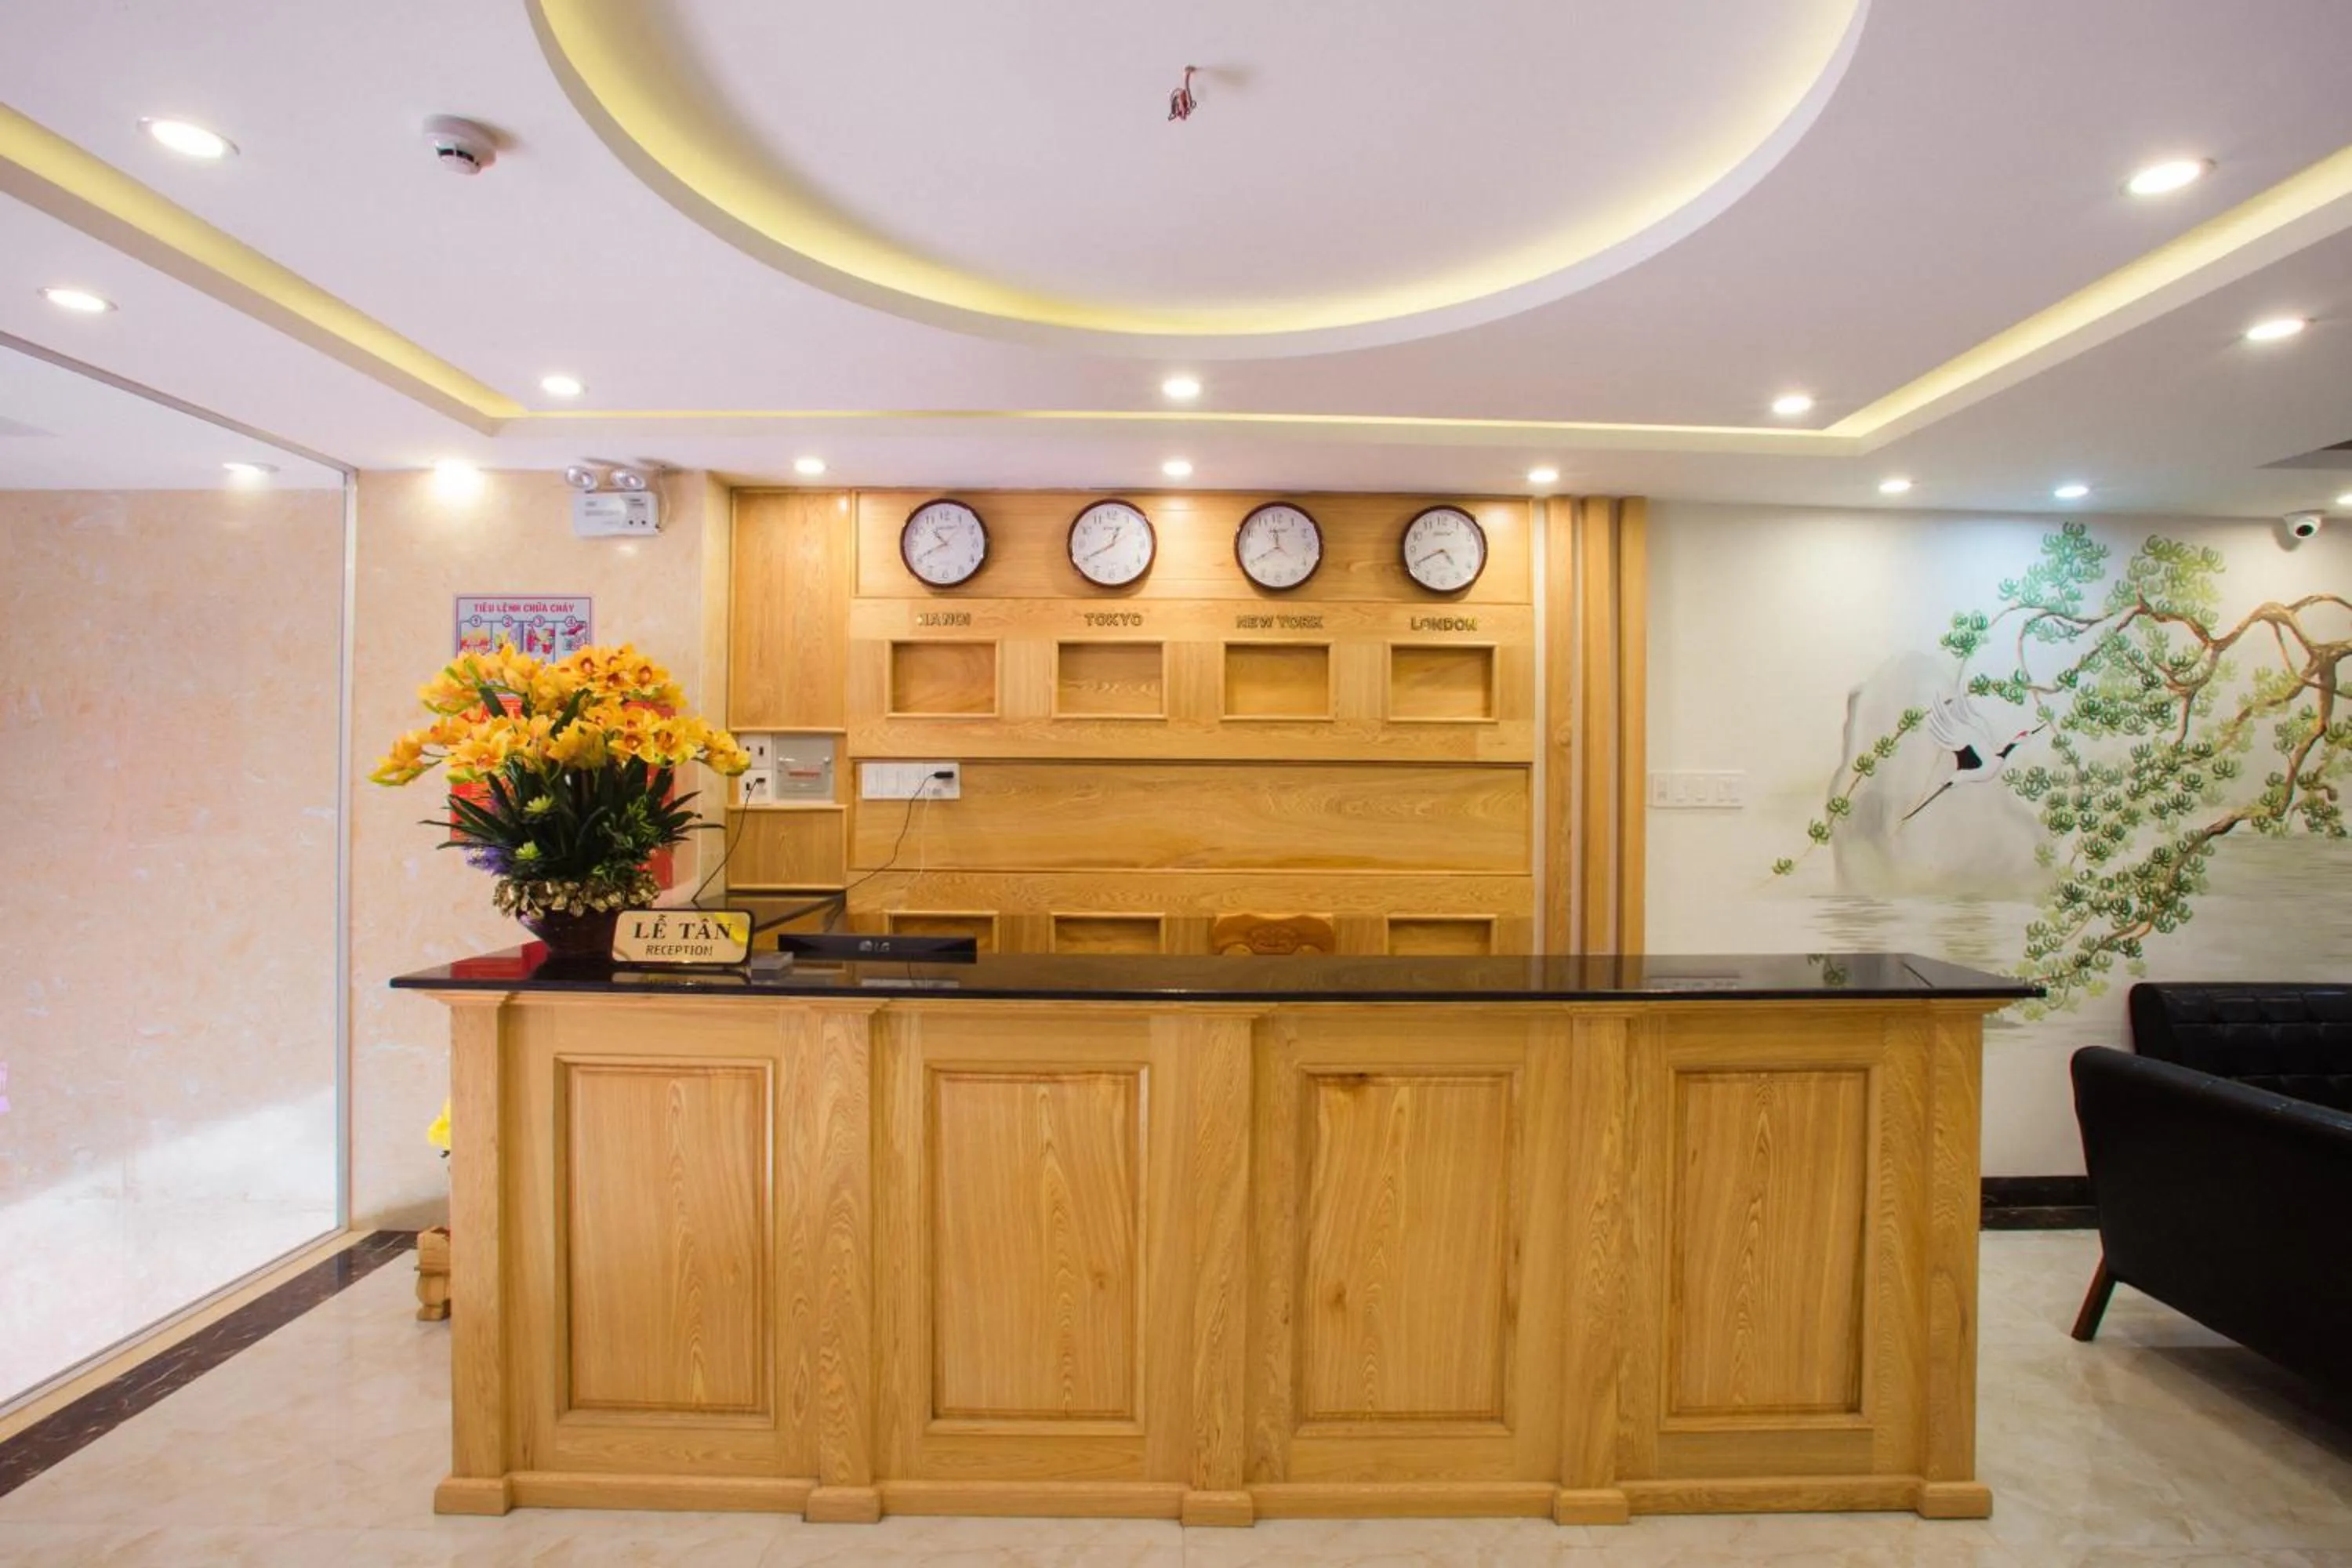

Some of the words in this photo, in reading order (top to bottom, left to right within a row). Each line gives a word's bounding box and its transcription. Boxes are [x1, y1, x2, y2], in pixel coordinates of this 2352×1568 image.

[1094, 514, 1102, 525] 11
[1083, 612, 1144, 626] TOKYO
[1236, 615, 1273, 628] NEW
[1276, 615, 1323, 628] YORK
[1410, 615, 1477, 630] LONDON
[633, 913, 666, 939] LỄ
[678, 918, 734, 939] TÂN
[645, 945, 713, 956] RECEPTION
